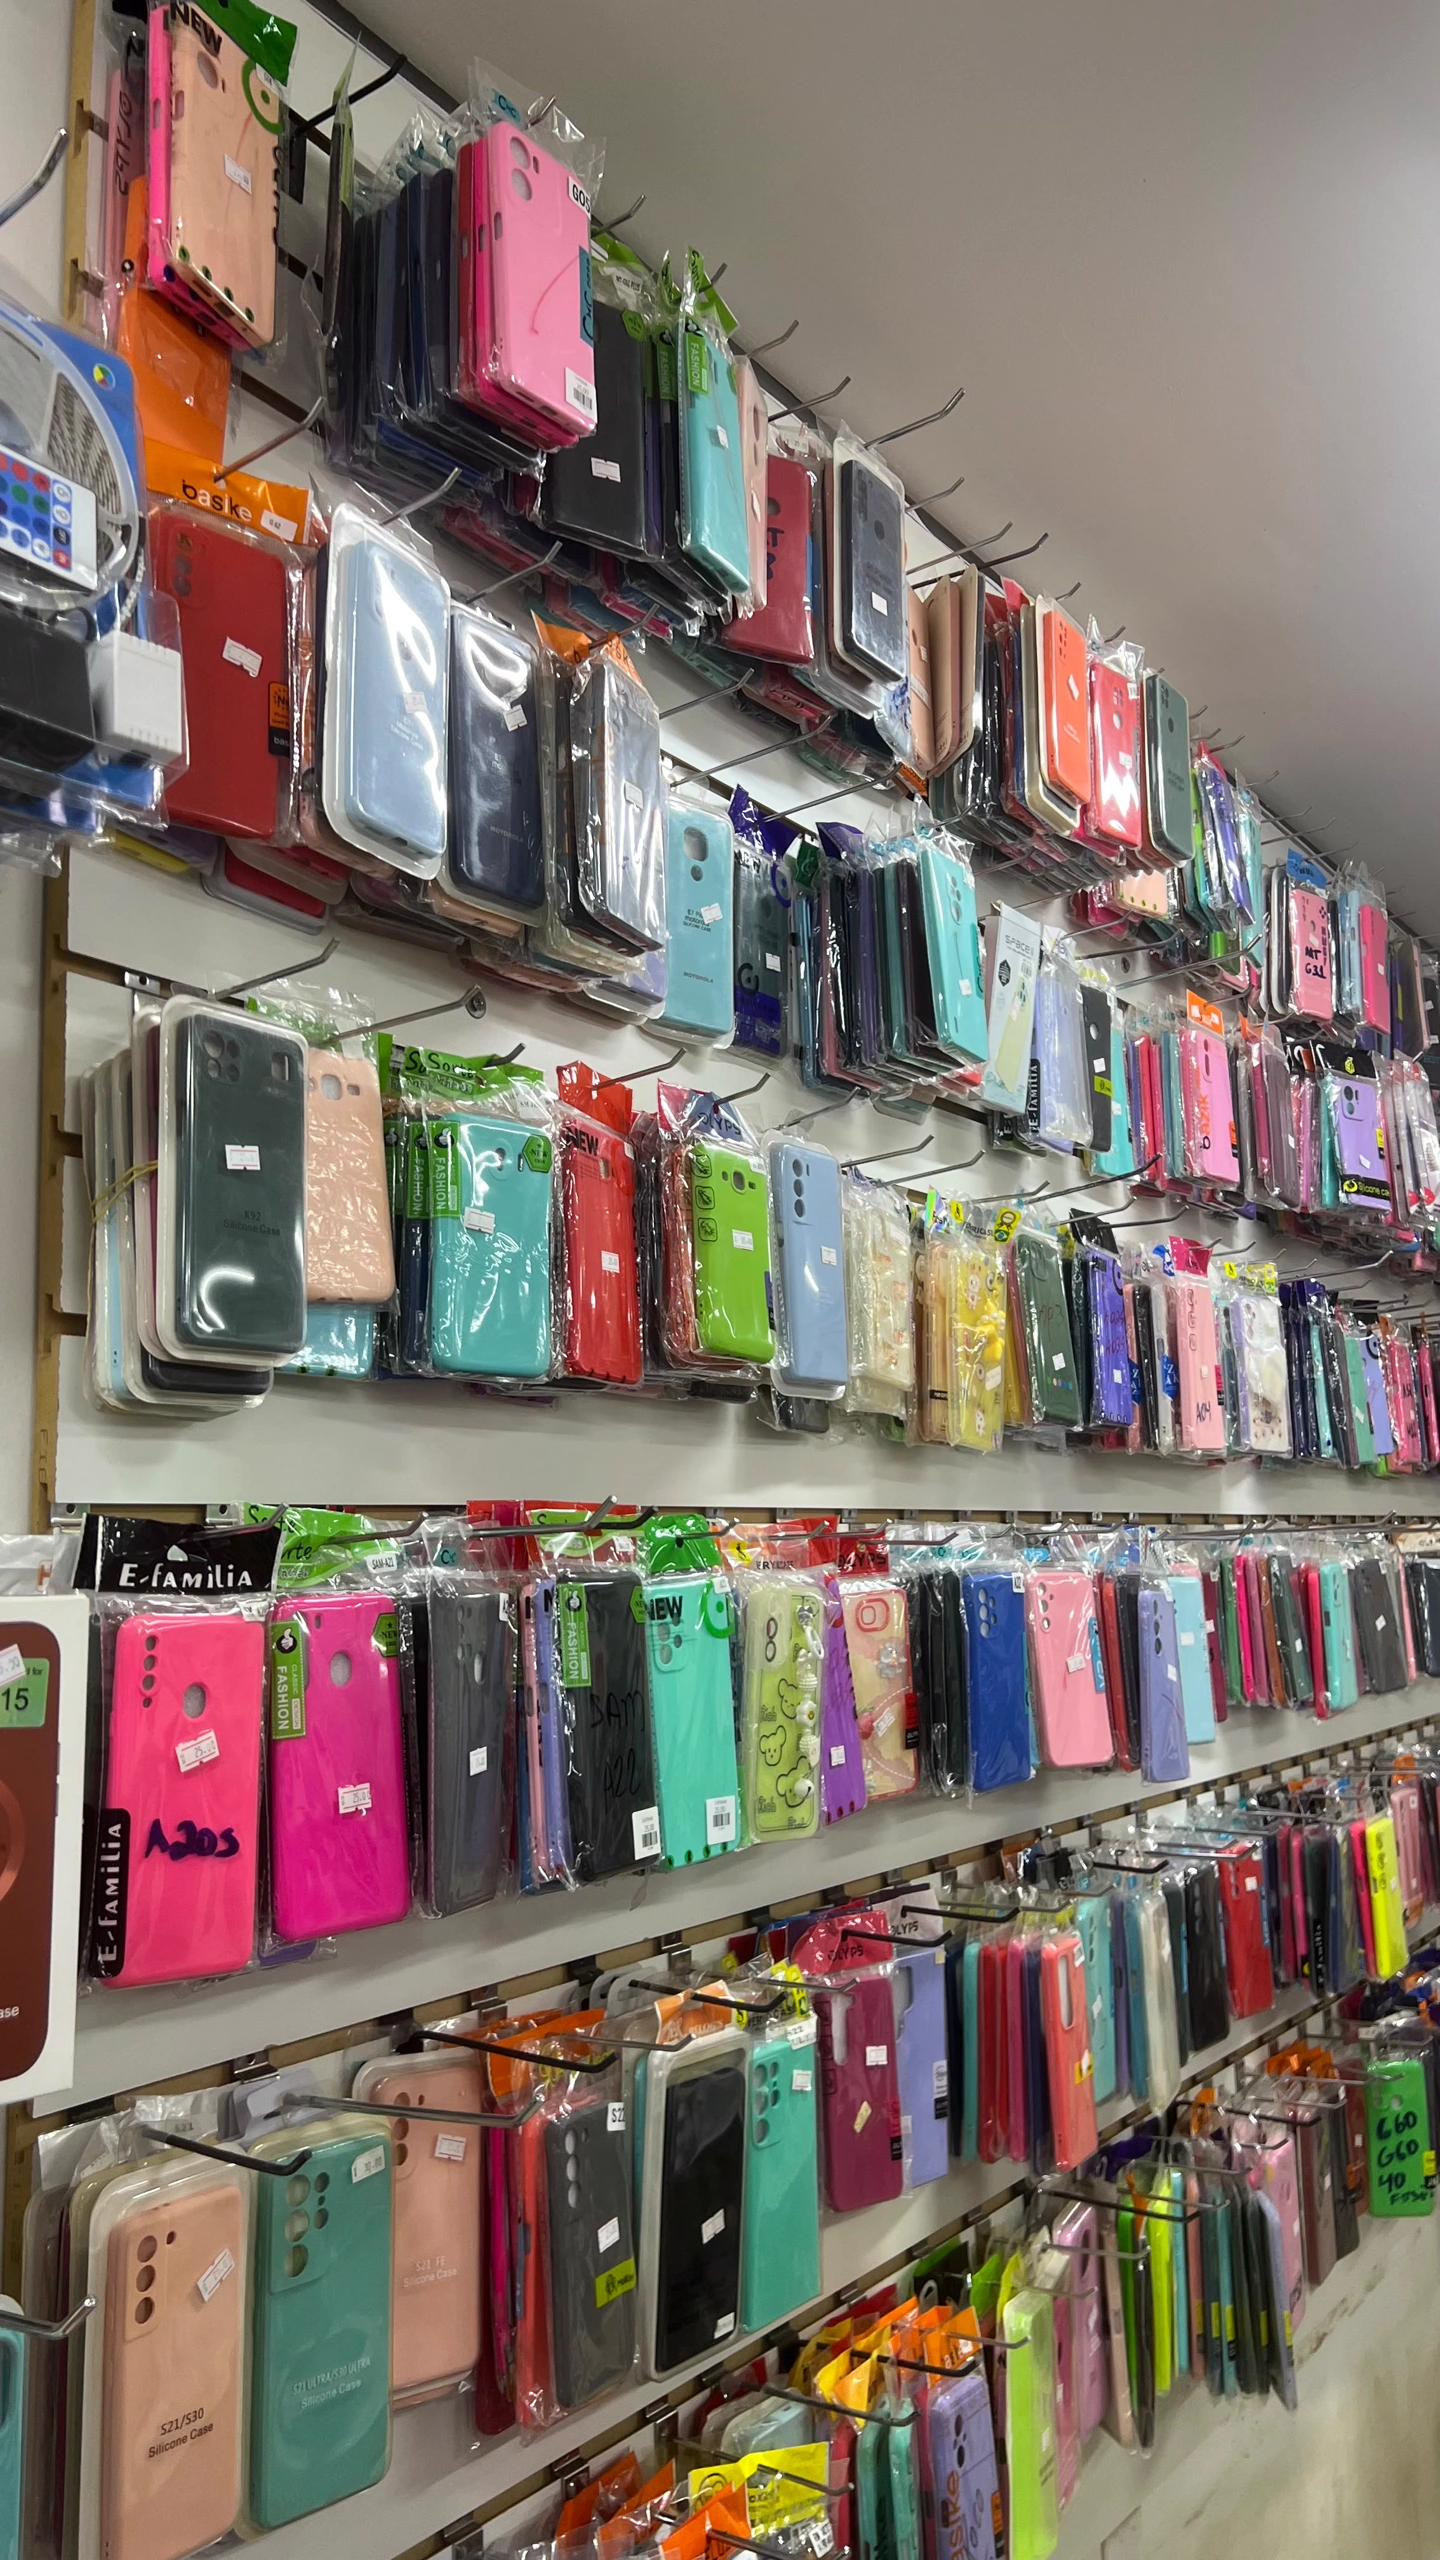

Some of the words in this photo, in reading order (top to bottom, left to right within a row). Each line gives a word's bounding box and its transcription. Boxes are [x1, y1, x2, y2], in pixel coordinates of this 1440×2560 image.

[170, 1, 222, 58] NEW
[659, 350, 669, 394] FASHION
[690, 342, 700, 387] FASHION
[182, 479, 252, 521] basike
[683, 971, 714, 984] MOTOROLA
[568, 1126, 599, 1157] NEW
[435, 1157, 446, 1210] FASHION
[223, 1219, 258, 1233] Silicone
[259, 1224, 281, 1236] Case
[244, 1209, 261, 1221] K92
[567, 1622, 579, 1680] FASHION
[1, 1687, 29, 1711] 15
[277, 1665, 289, 1731] FASHION
[415, 2258, 432, 2272] S21
[436, 2267, 458, 2280] Case
[292, 2380, 307, 2396] S21
[347, 2356, 371, 2375] ULTRA
[301, 2387, 337, 2410] Silicone
[338, 2378, 362, 2395] Case
[160, 2406, 205, 2437] S21/S30
[148, 2434, 188, 2459] Silicone
[190, 2421, 214, 2441] Case
